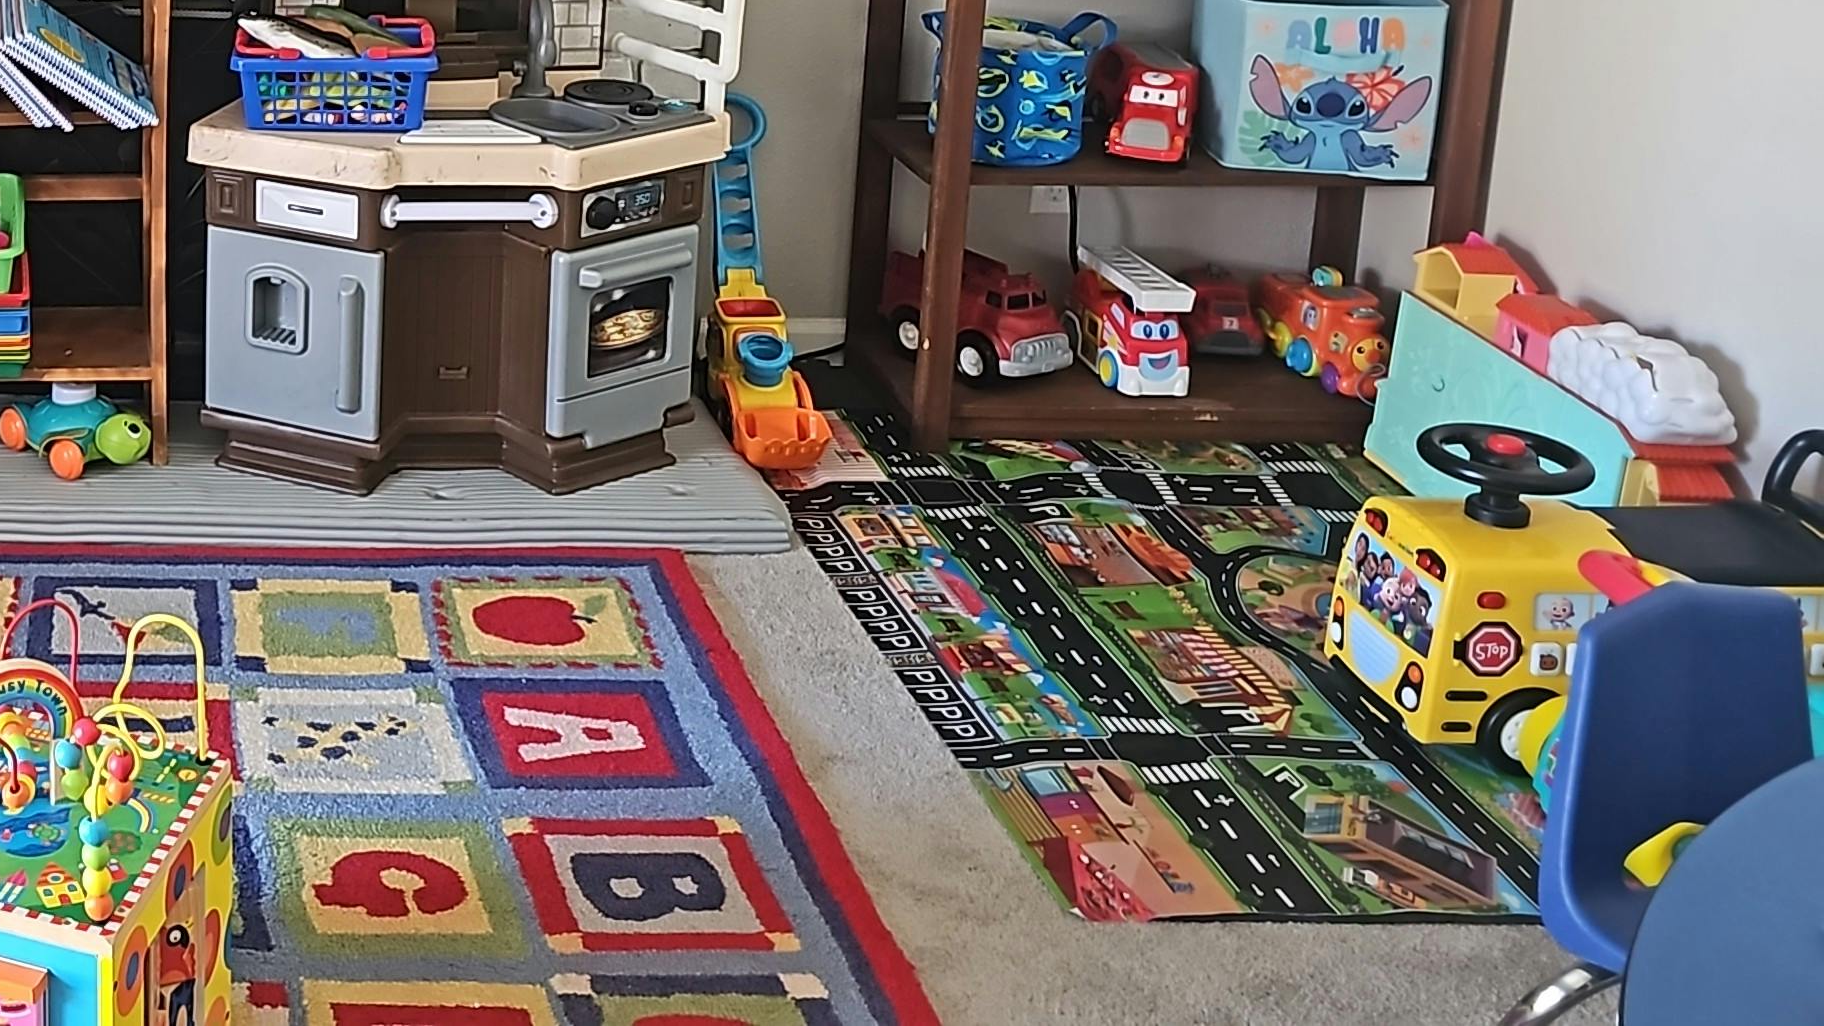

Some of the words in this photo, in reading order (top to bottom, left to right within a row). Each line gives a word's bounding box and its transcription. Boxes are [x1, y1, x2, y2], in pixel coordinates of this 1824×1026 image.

[1286, 16, 1405, 55] ALOHA
[1028, 505, 1061, 517] P
[797, 518, 825, 530] P
[806, 532, 834, 543] P
[815, 546, 845, 557] P
[825, 560, 855, 572] P
[844, 589, 875, 602] P
[857, 605, 888, 618] P
[868, 621, 900, 634] P
[879, 636, 912, 650] P
[1475, 642, 1509, 661] STOP
[903, 670, 937, 684] P
[36, 679, 69, 717] Town
[916, 688, 950, 702] P
[929, 706, 963, 719] P
[1221, 709, 1261, 723] P
[503, 705, 647, 763] A
[942, 724, 977, 738] P
[1274, 770, 1301, 788] P
[311, 849, 470, 918] G
[570, 851, 727, 922] B
